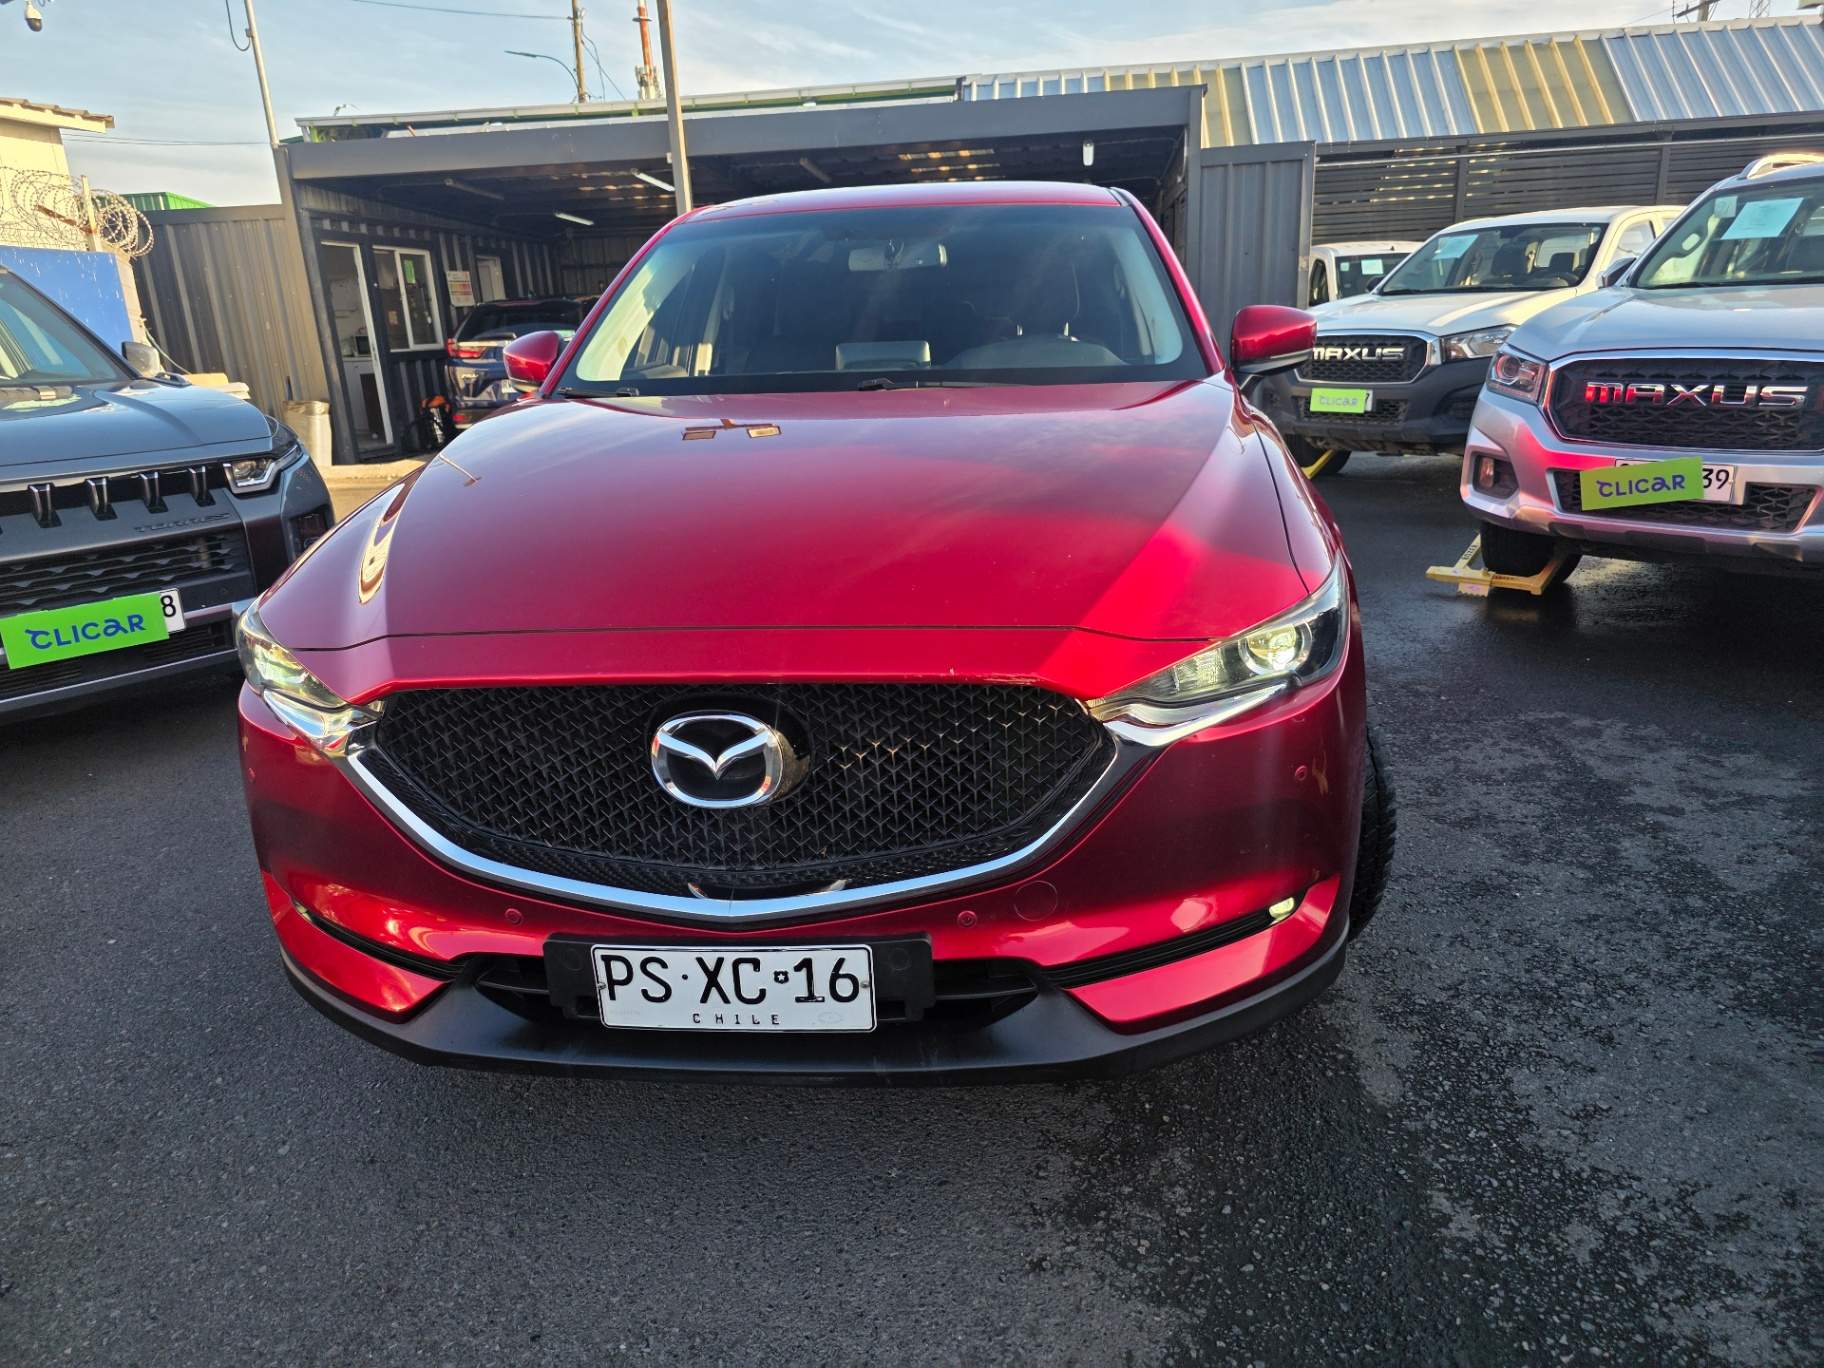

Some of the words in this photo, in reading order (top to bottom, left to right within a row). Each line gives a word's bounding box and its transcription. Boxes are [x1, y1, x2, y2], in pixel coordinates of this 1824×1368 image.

[1312, 346, 1406, 361] MAXUS
[1585, 382, 1809, 407] MAXUS
[692, 1012, 780, 1025] CHILE
